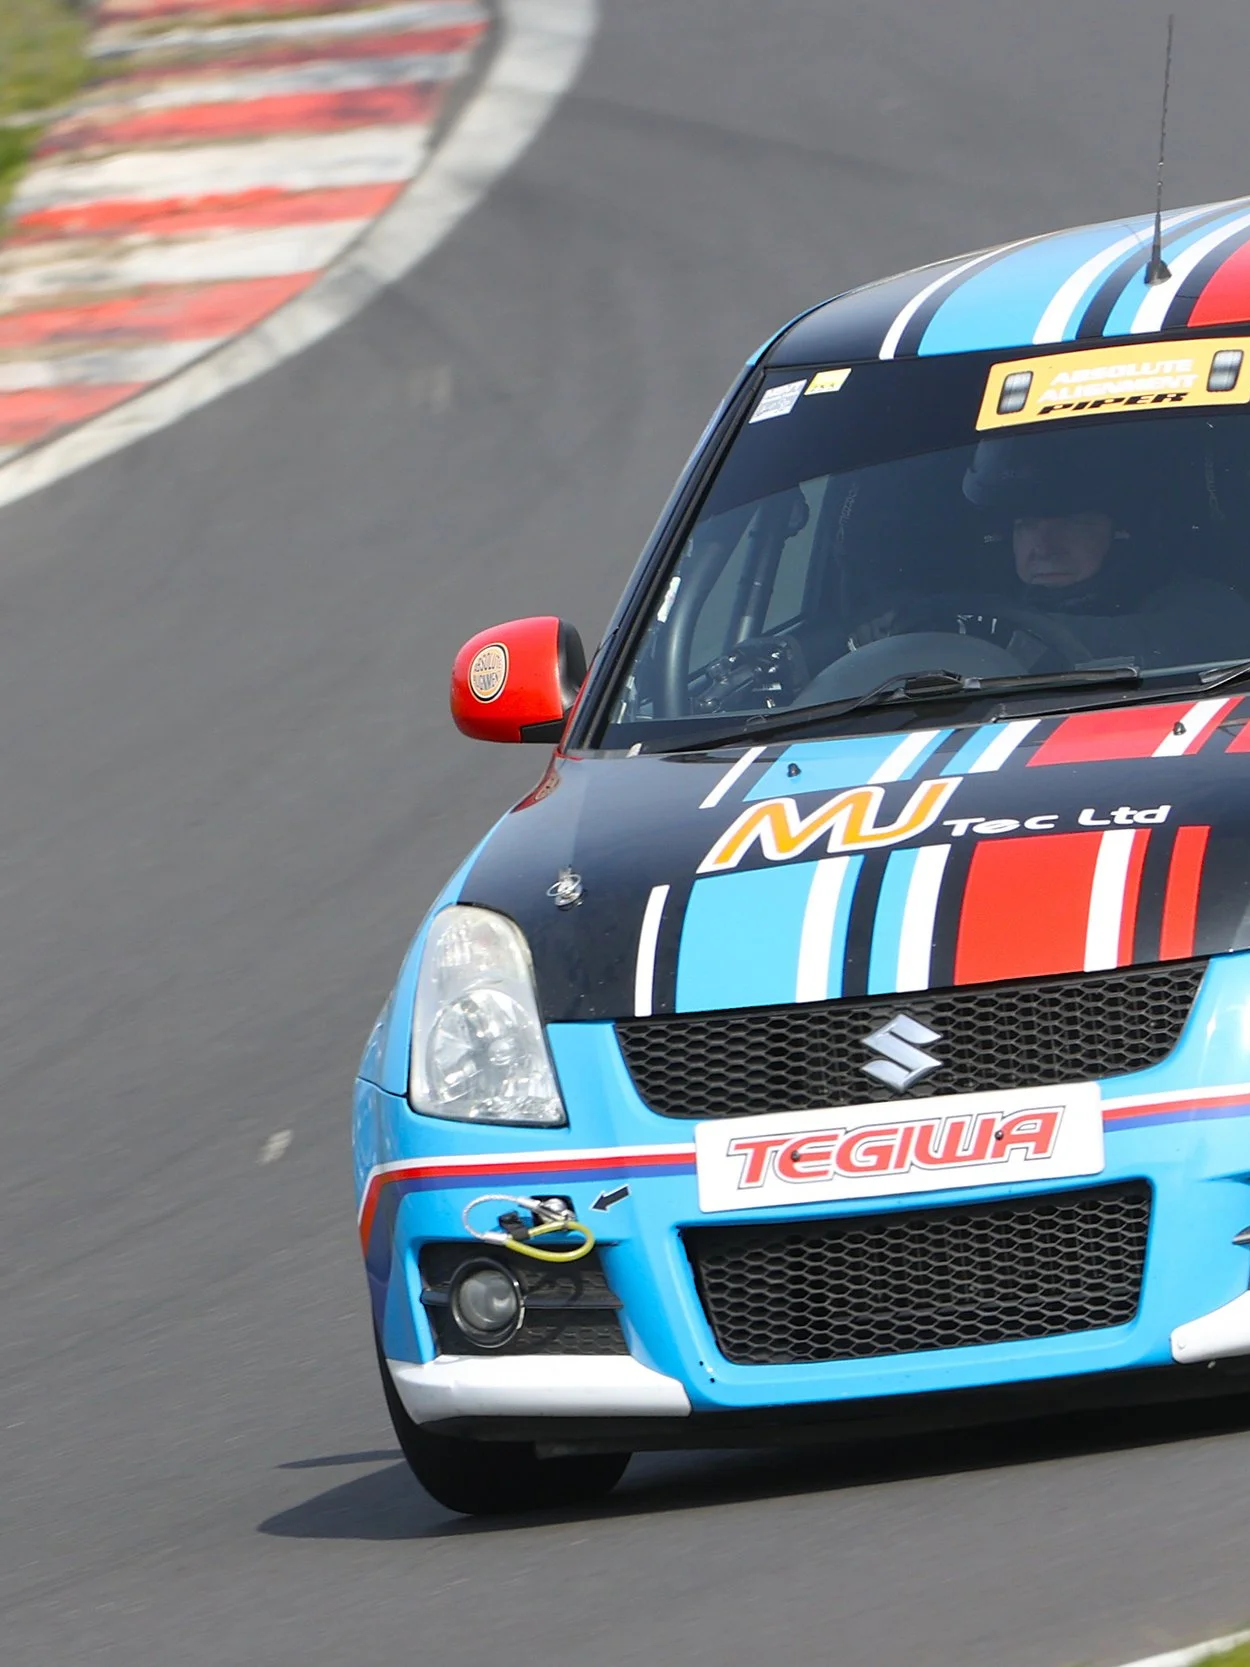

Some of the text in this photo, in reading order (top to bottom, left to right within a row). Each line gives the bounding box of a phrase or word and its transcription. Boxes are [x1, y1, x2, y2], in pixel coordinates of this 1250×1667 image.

[1050, 358, 1194, 387] ABSOLUTE
[1037, 392, 1189, 416] PIPER
[1038, 374, 1199, 404] ALIGNMENT
[942, 814, 1059, 837] Tec
[1077, 804, 1172, 826] Ltd
[727, 1106, 1067, 1189] TEGIWA
